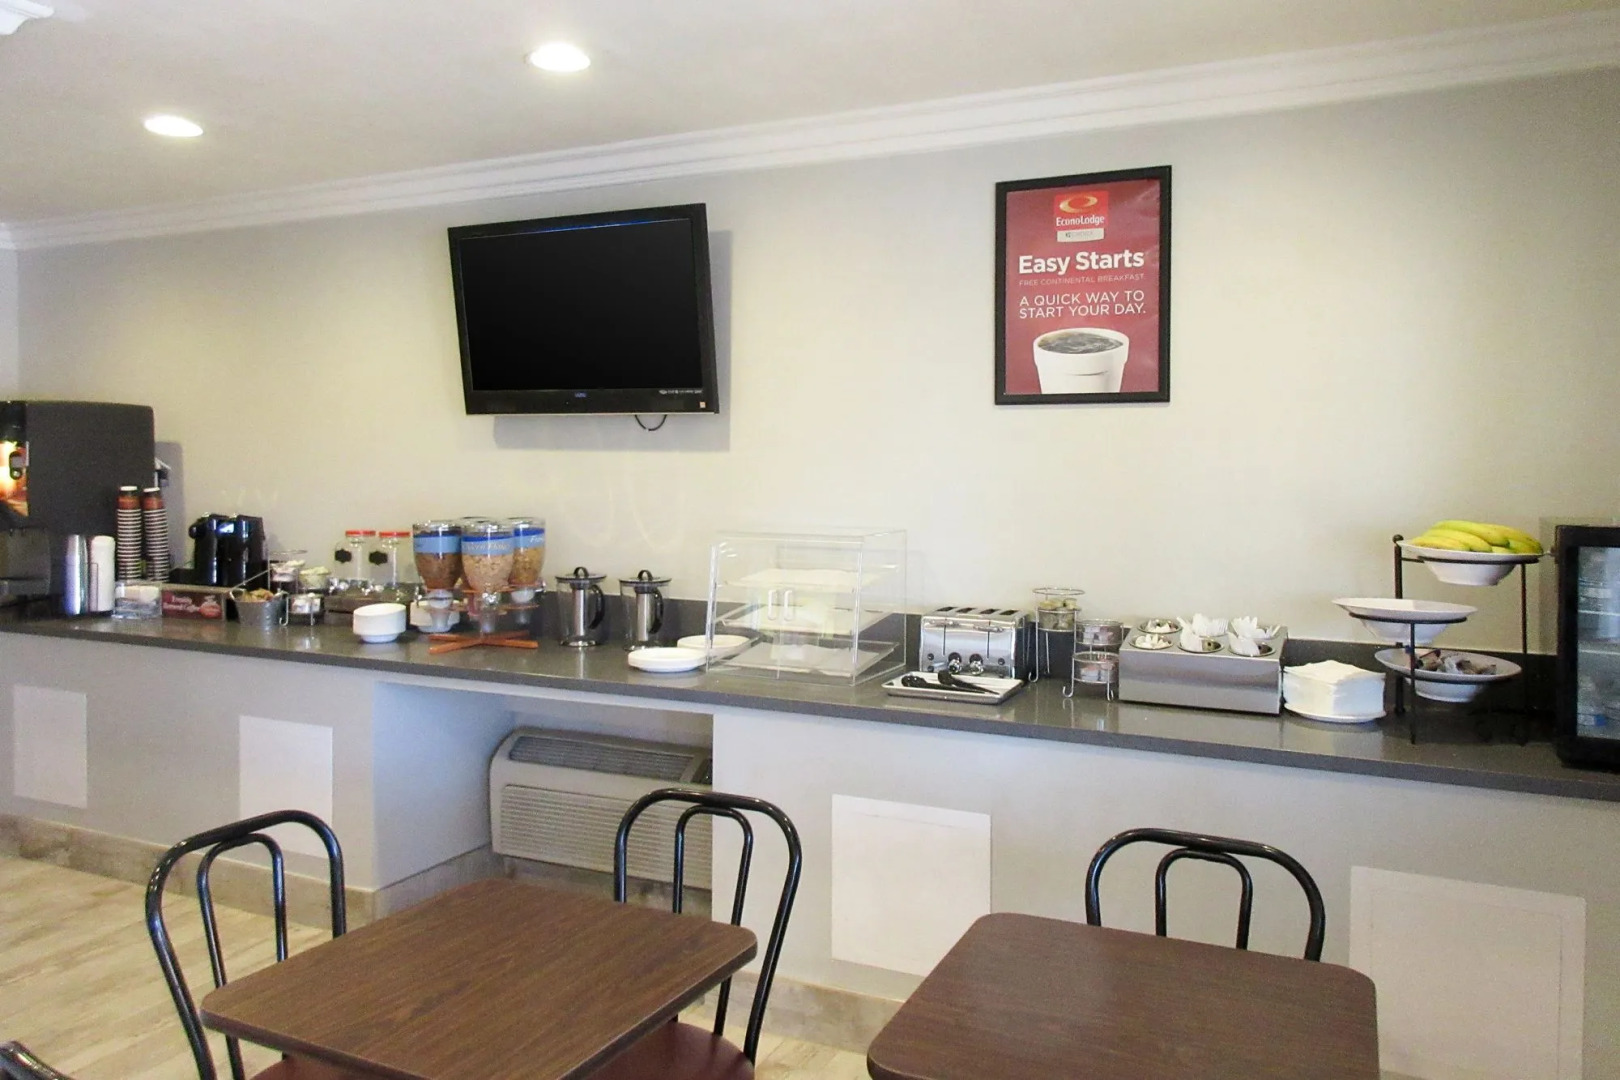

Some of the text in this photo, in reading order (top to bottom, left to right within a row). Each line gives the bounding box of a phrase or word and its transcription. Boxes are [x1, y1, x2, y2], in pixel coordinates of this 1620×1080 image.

[1019, 249, 1145, 275] Easy Starts
[1040, 276, 1096, 286] CONTINENTAL
[1097, 273, 1144, 283] BREAKFAST
[1019, 290, 1145, 307] A QUICK WAY TO
[1019, 302, 1146, 319] START YOUR DAY.
